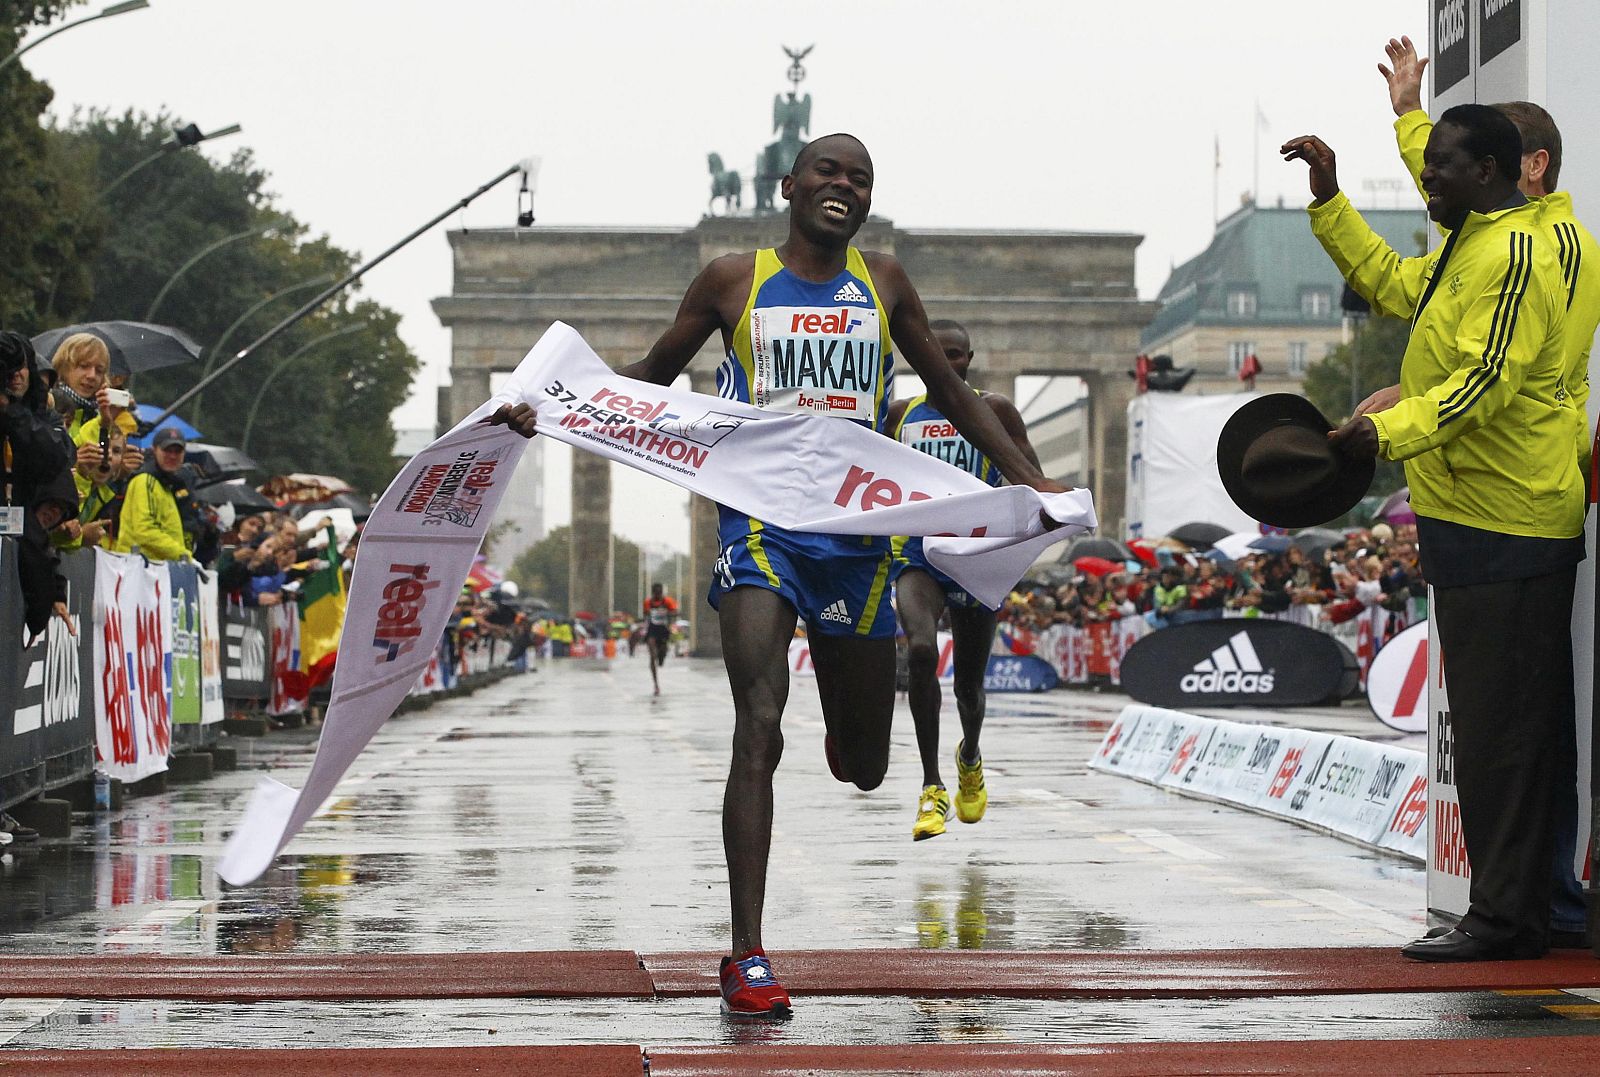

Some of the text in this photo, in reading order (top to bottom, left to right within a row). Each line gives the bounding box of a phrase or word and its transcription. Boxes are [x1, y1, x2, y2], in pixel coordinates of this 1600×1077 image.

[833, 292, 868, 303] adidas
[773, 339, 875, 393] MAKAU
[832, 398, 855, 409] Berlin
[559, 412, 709, 469] MRATHON
[582, 431, 635, 456] Schirmherrschaft
[634, 450, 645, 460] der
[645, 454, 696, 477] Bundeskanzlerin
[911, 440, 976, 473] UTAI
[403, 462, 451, 514] MARATHON
[820, 611, 852, 625] adidas
[1180, 670, 1275, 694] adidas
